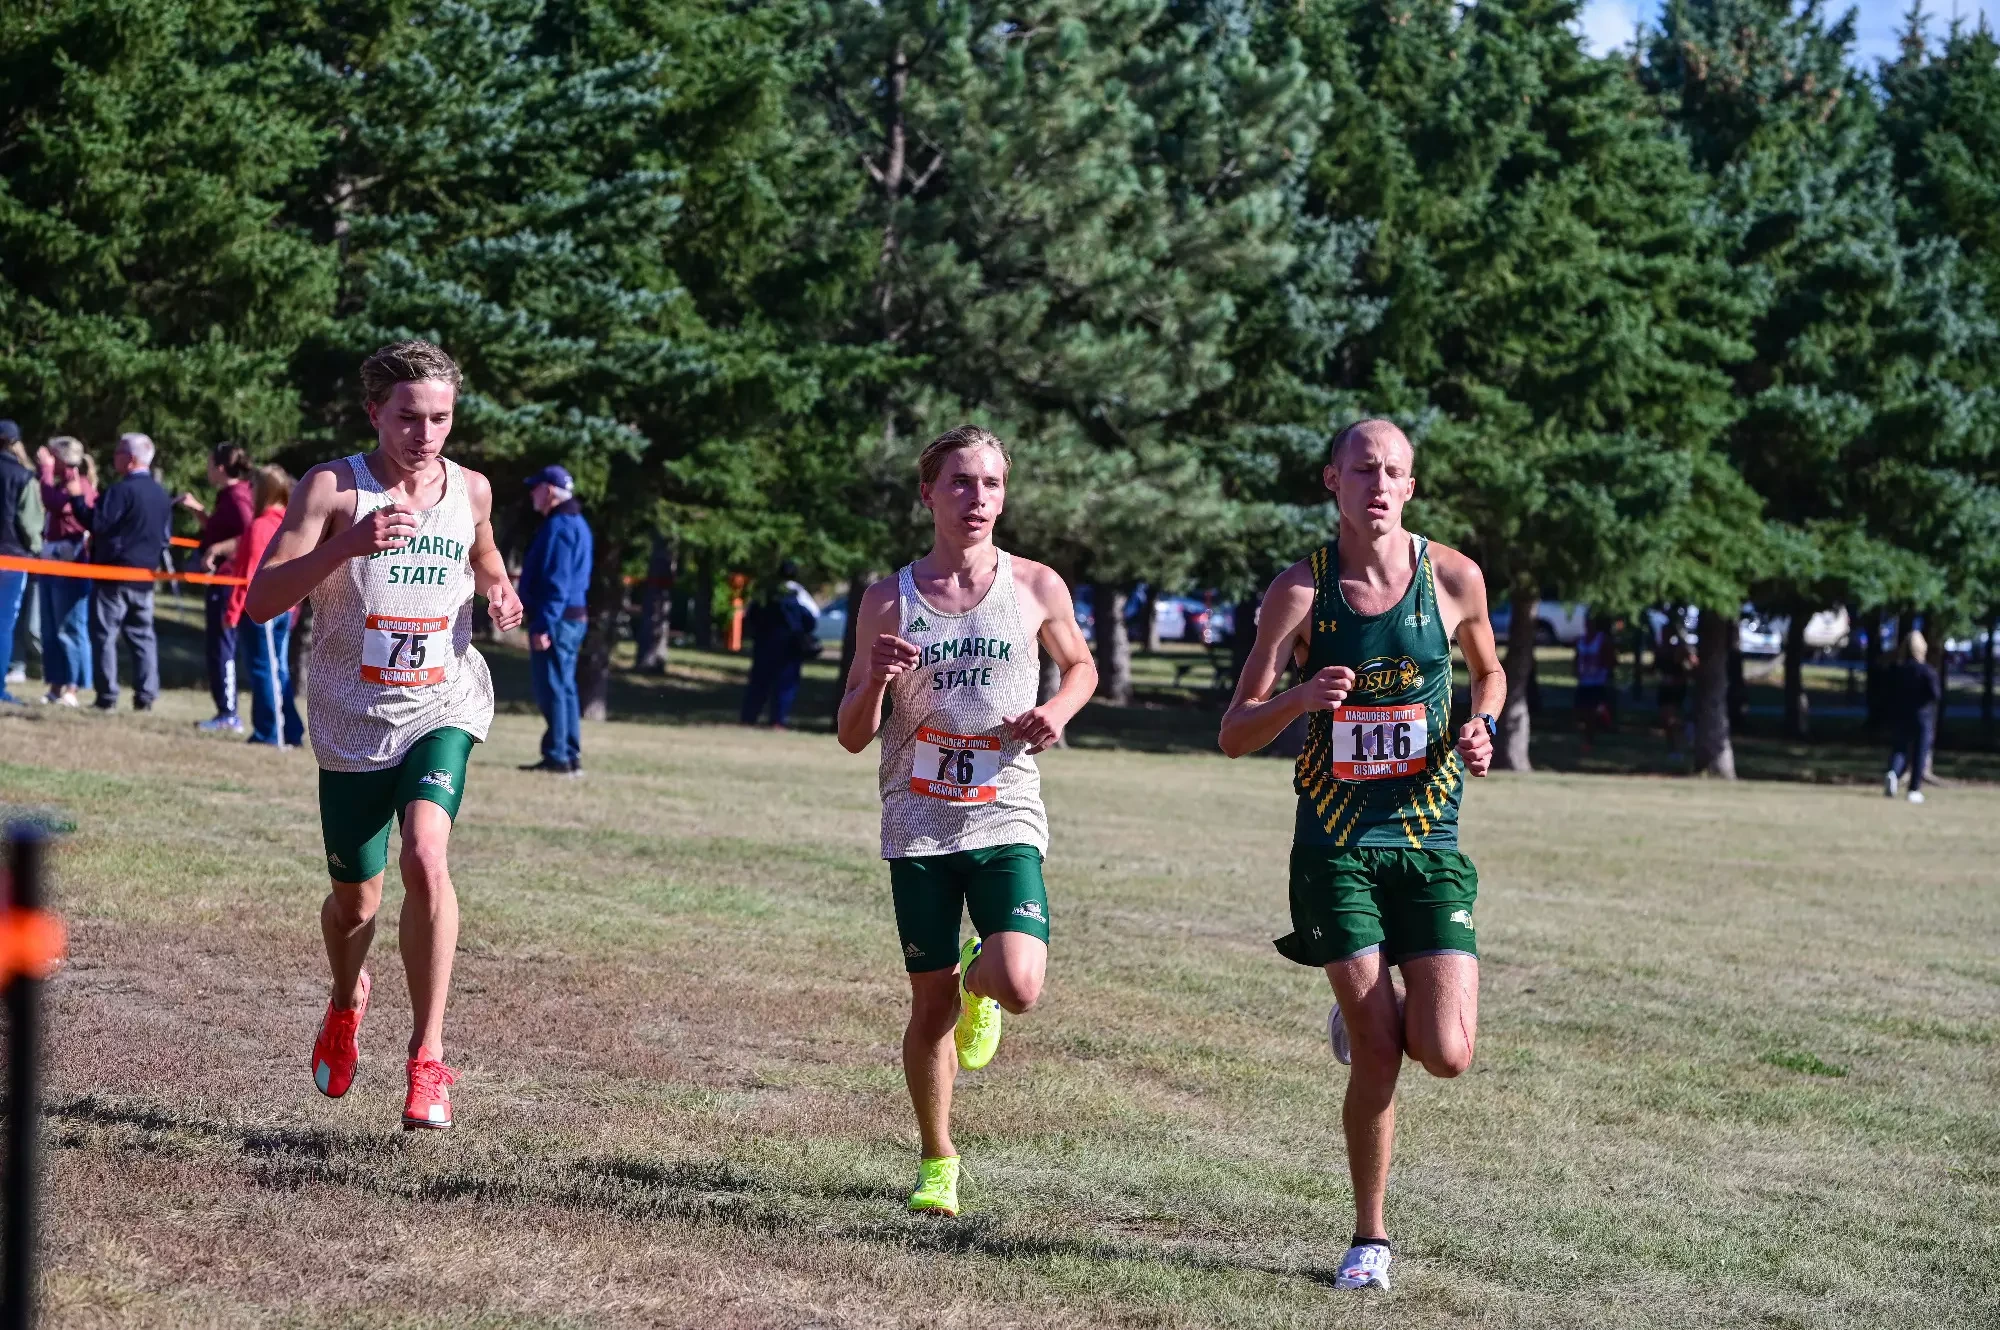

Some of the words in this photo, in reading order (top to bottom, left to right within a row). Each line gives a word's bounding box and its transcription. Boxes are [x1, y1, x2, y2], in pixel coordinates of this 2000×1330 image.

[370, 536, 464, 563] SMARCK
[387, 565, 448, 585] STATE
[377, 620, 420, 631] MARAUDERS
[388, 633, 428, 668] 75
[418, 670, 428, 681] ND
[932, 667, 993, 690] STATE
[1345, 711, 1390, 721] MARAUDERS
[1393, 709, 1416, 720] INVITE
[926, 733, 966, 748] MARAUDERS
[968, 740, 990, 748] INVITE
[1351, 723, 1411, 761] 116
[937, 747, 974, 784] 76
[1396, 762, 1408, 773] ND
[967, 787, 978, 798] ND
